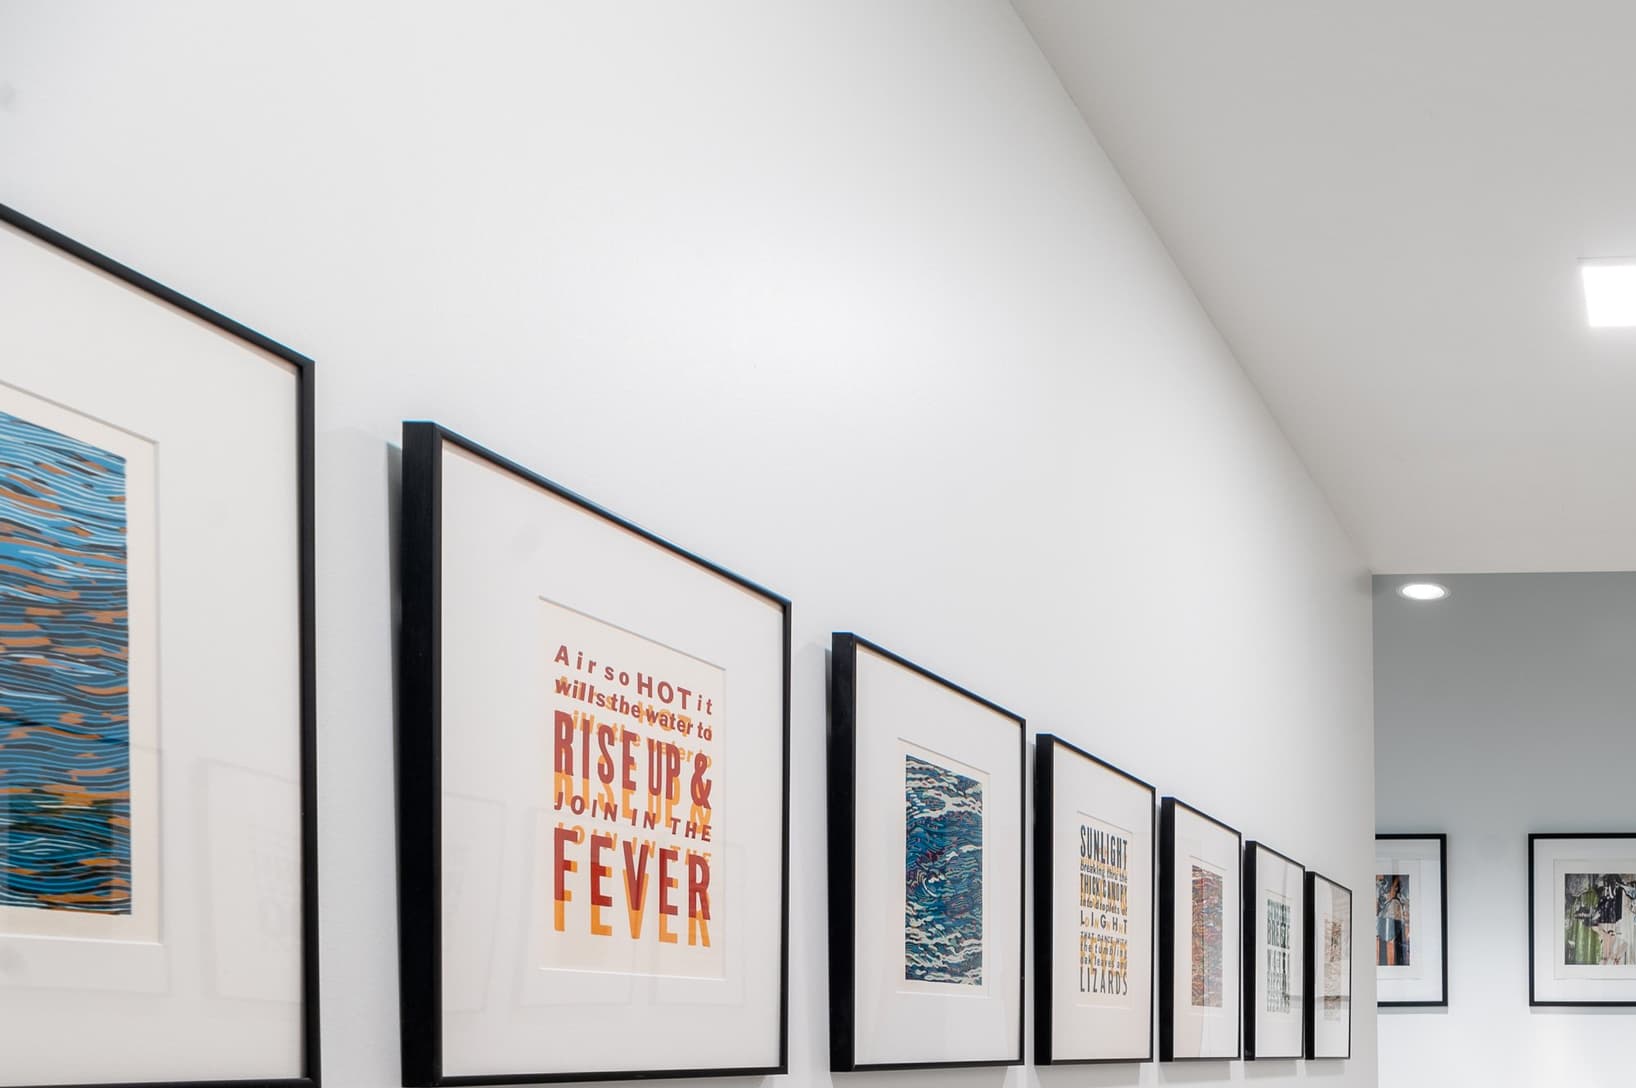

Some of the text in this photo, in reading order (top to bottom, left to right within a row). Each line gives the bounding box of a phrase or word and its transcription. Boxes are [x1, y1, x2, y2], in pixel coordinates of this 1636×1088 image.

[554, 645, 713, 716] Air so HOT it
[609, 692, 641, 719] the
[645, 707, 694, 734] water
[697, 722, 713, 741] to
[554, 710, 712, 810] RISE UP &
[554, 791, 712, 843] JOIN IN THE
[1080, 824, 1128, 871] SUNLIGHT
[1080, 860, 1106, 880] breaking
[553, 827, 712, 920] FEVER
[1080, 872, 1100, 895] THICK
[1080, 910, 1128, 936] LIGHT
[1080, 966, 1128, 996] LIZARDS
